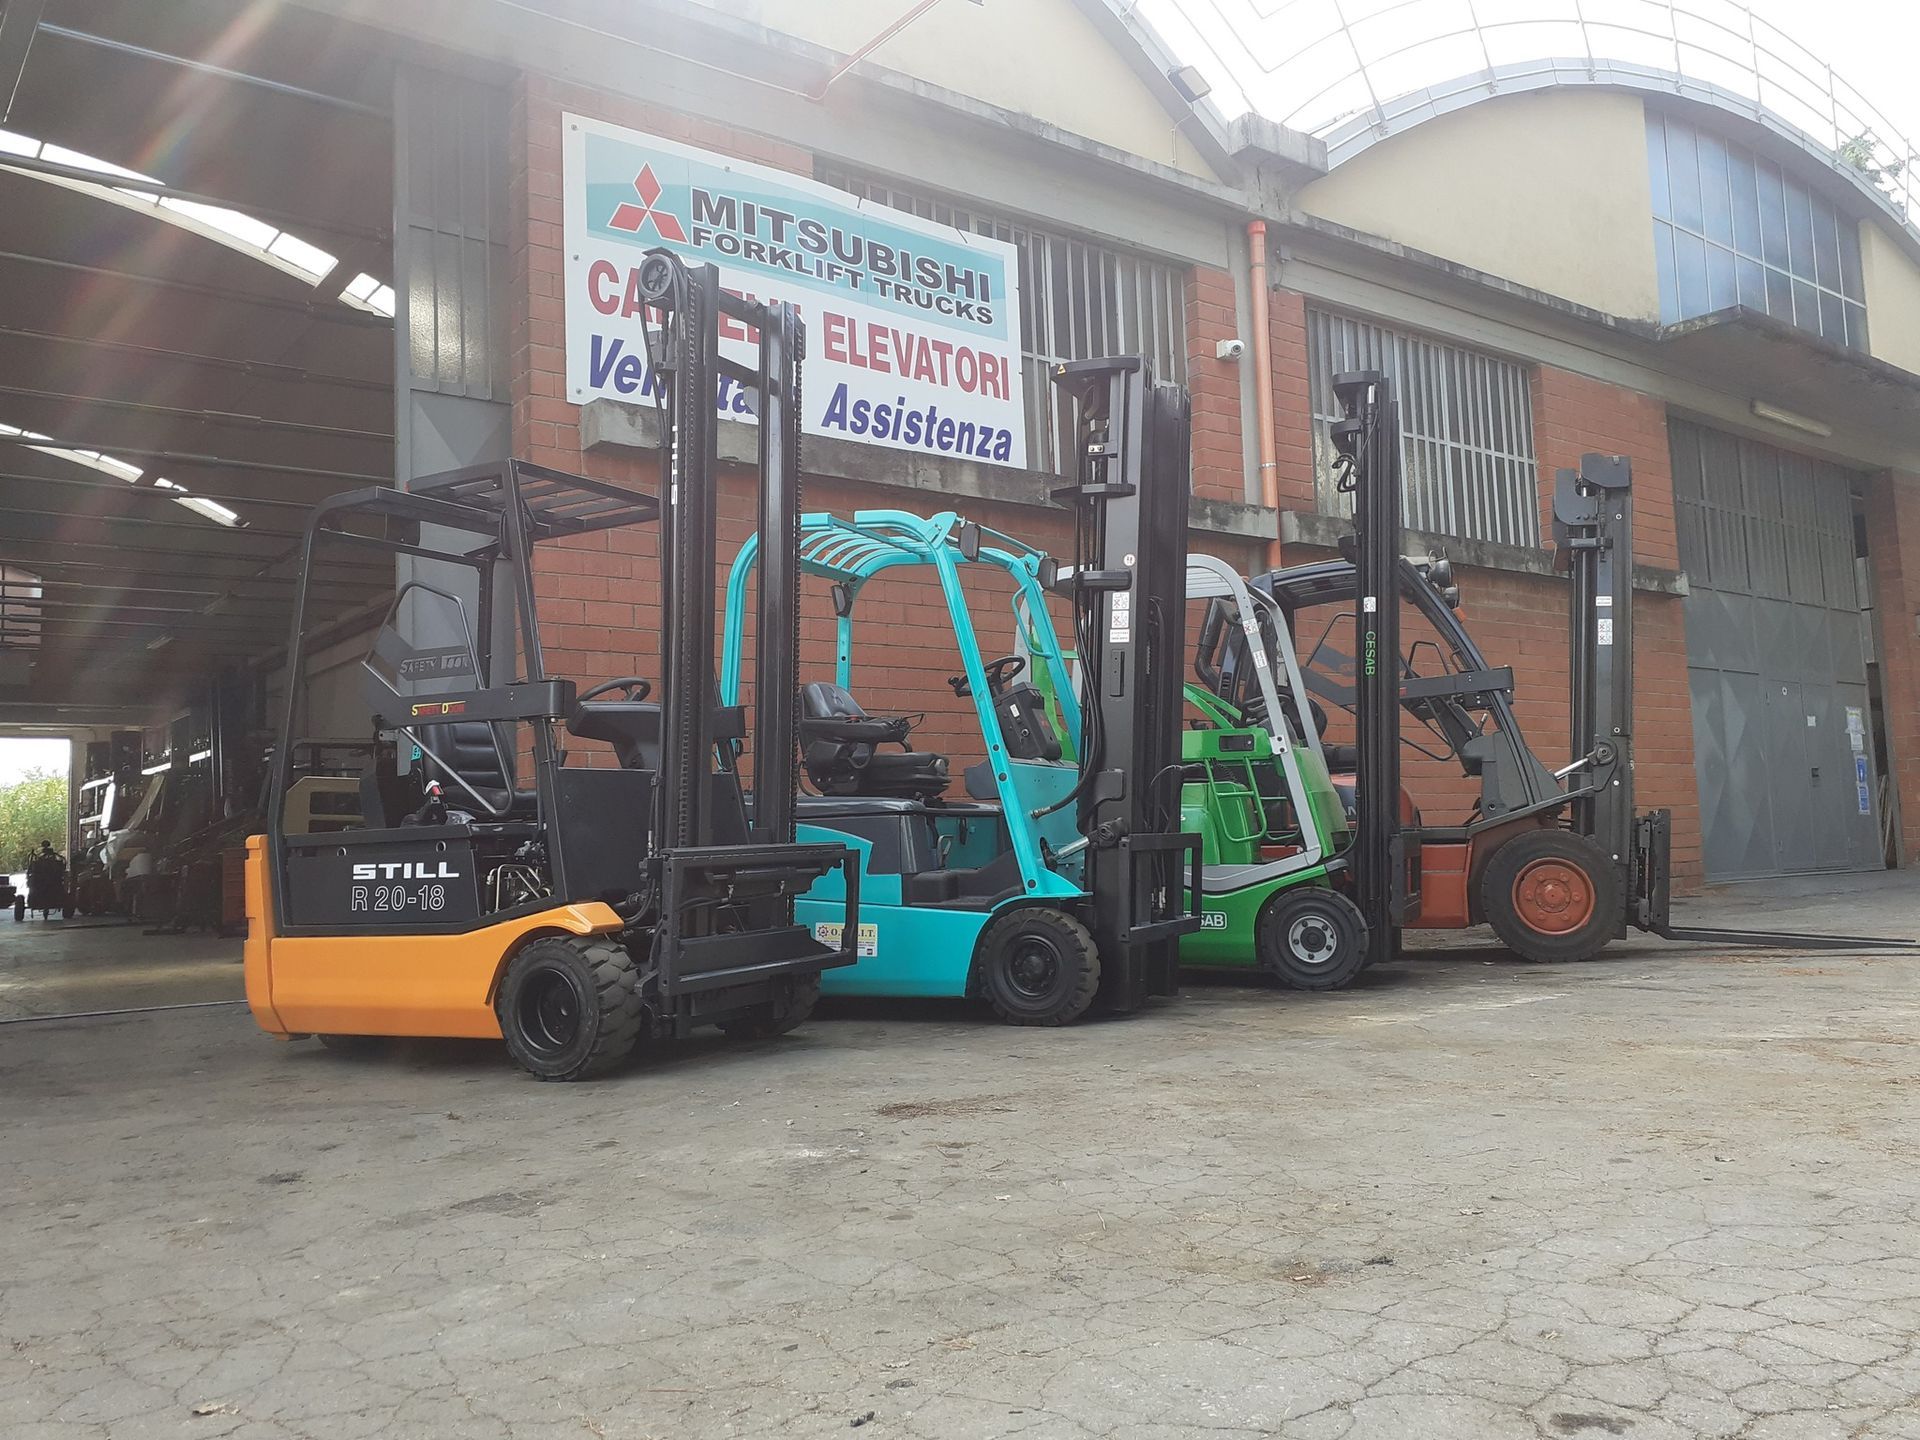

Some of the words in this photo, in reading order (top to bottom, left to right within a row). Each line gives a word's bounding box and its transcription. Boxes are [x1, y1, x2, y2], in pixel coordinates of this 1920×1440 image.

[692, 188, 990, 304] MITSUBISHI
[692, 227, 865, 290] FORKLIFT
[873, 276, 994, 326] TRUCKS
[823, 311, 1010, 401] ELEVATORI
[821, 382, 1012, 463] Assistenza
[1365, 631, 1376, 675] CESAB
[351, 885, 368, 911] R
[374, 884, 445, 911] 20-18
[352, 861, 460, 880] STILL
